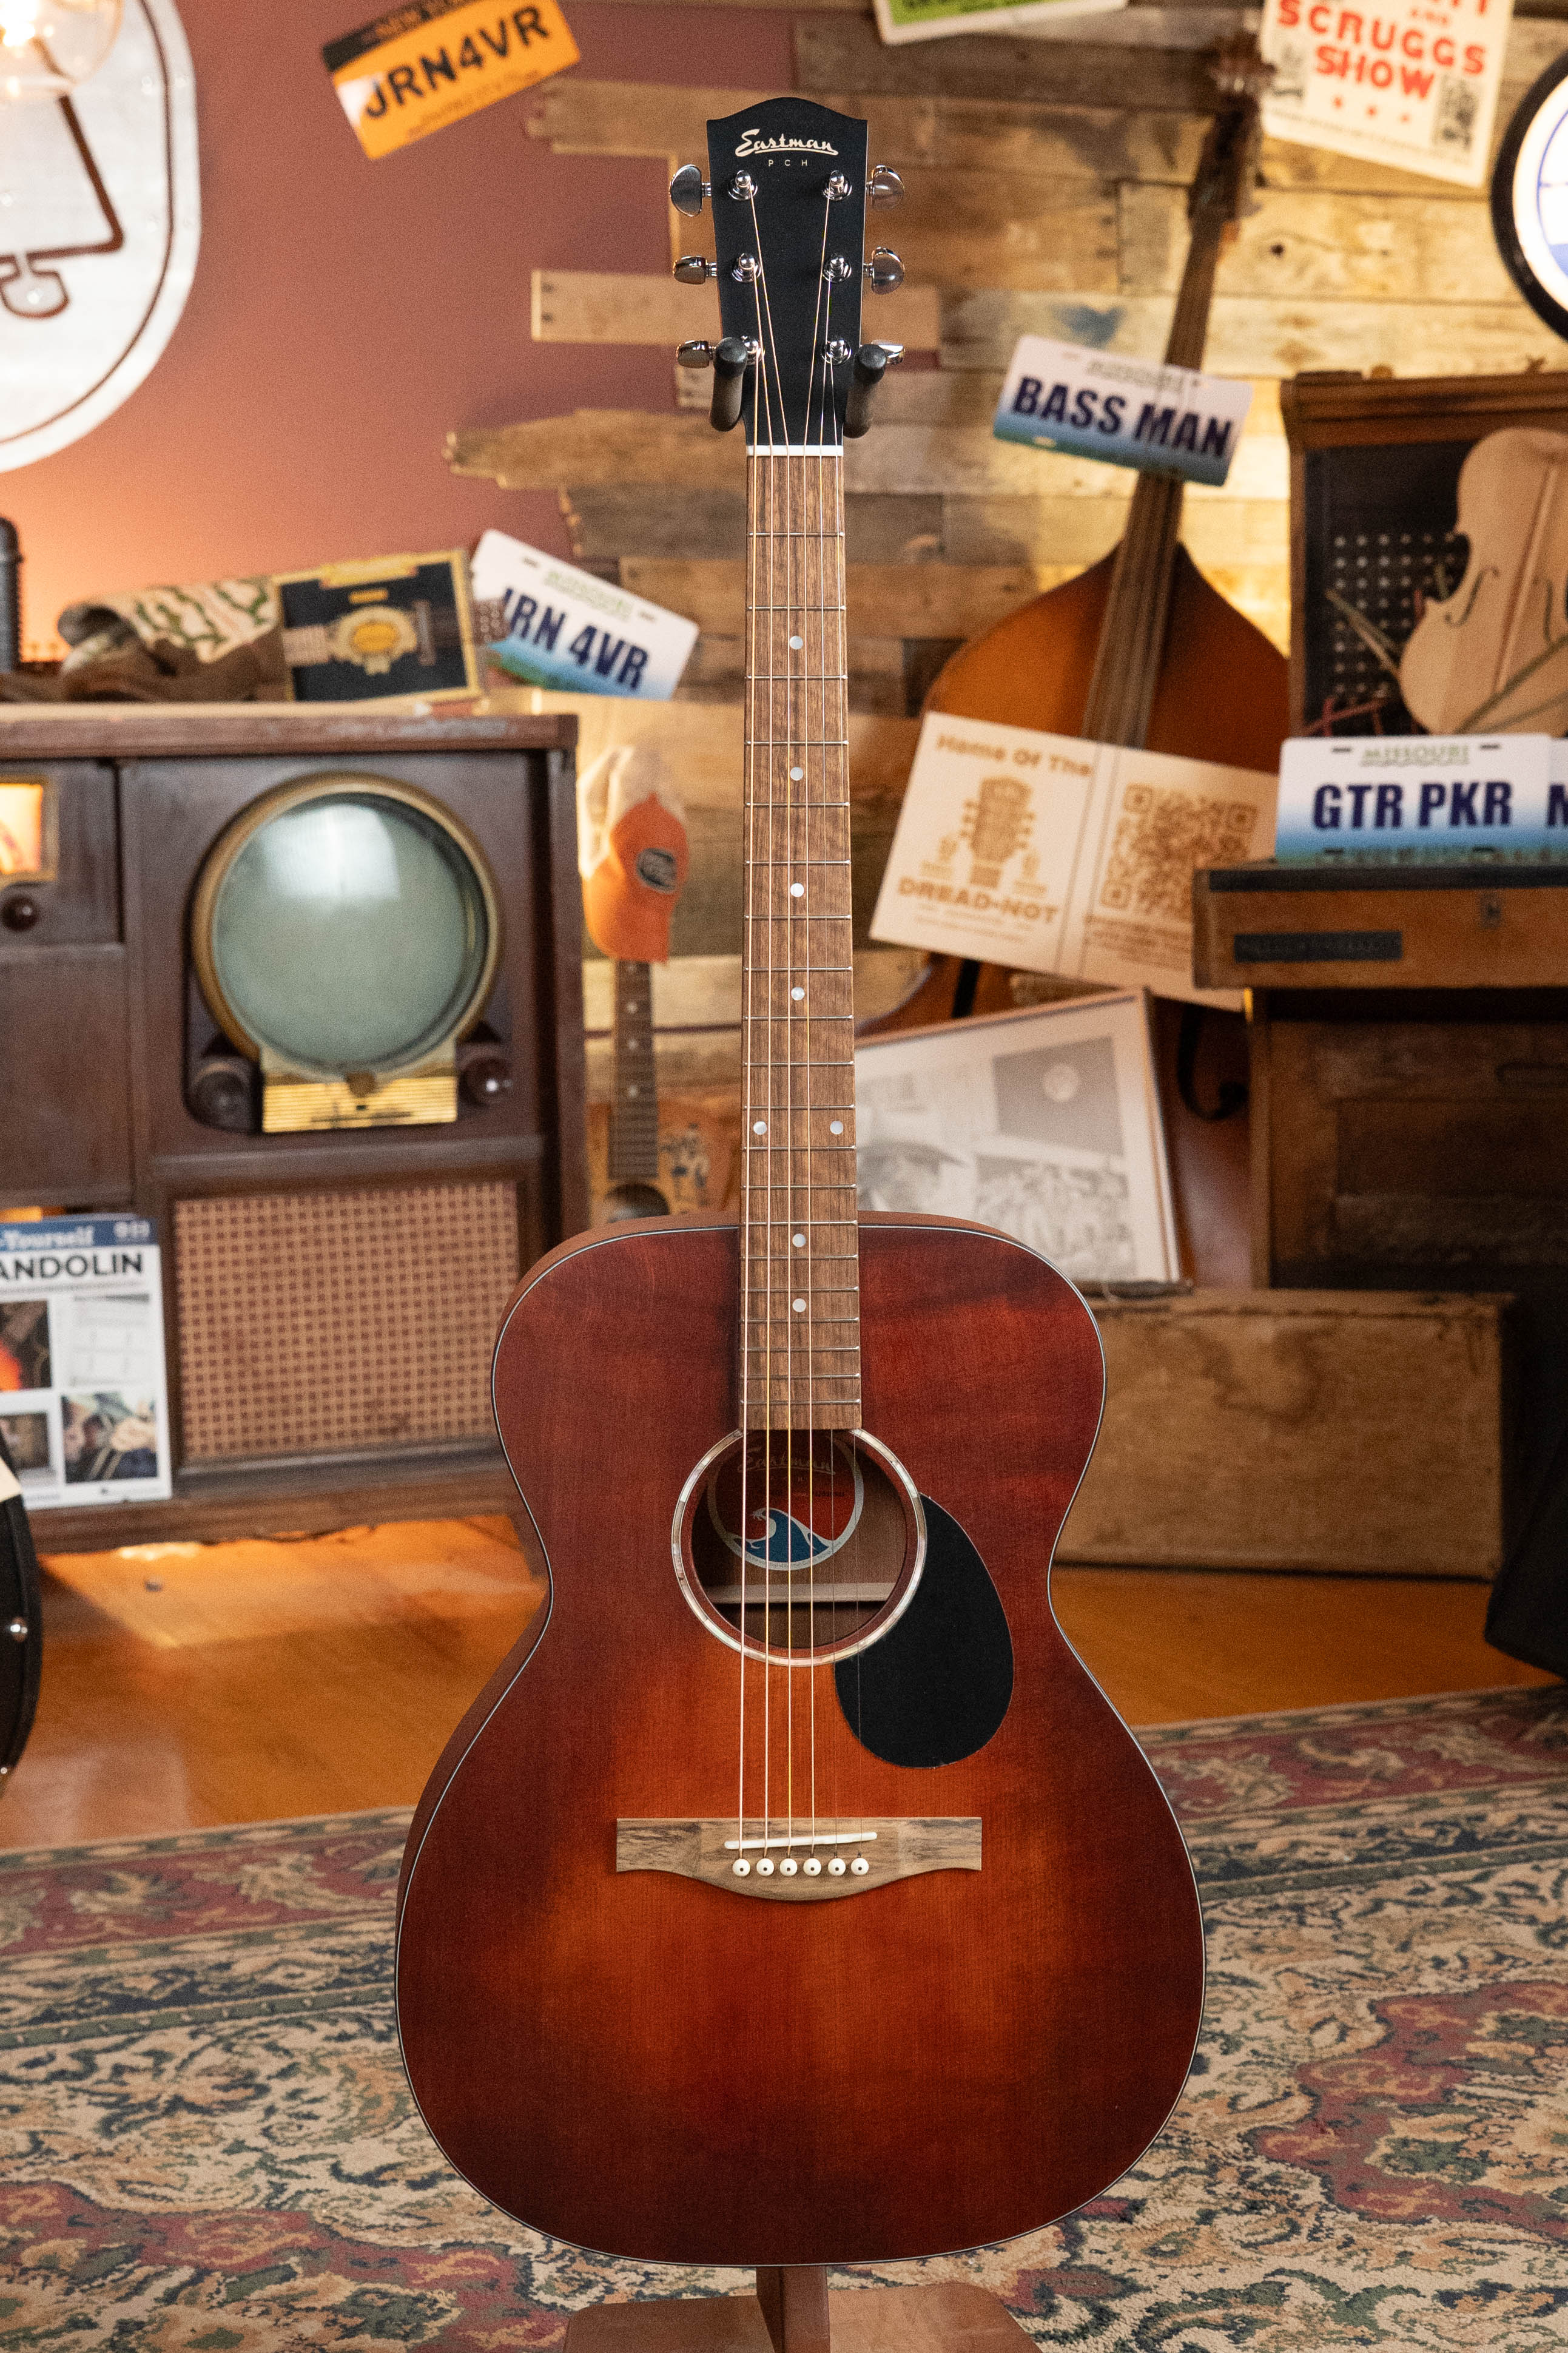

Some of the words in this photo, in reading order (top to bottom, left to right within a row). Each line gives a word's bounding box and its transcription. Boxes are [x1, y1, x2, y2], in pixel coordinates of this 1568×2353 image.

[365, 5, 550, 118] JRN4VR
[1277, 0, 1485, 74] SCRUGGS
[1316, 44, 1434, 100] SHOW
[735, 129, 839, 157] Eastman
[1011, 376, 1126, 434] BASS
[1134, 402, 1232, 457] MAN
[569, 625, 649, 690] 4VR
[1012, 747, 1042, 768] Of
[1048, 754, 1092, 777] The
[1362, 744, 1470, 766] MISSOURI
[1312, 783, 1404, 829] GTR
[1418, 782, 1512, 828] PKR
[898, 877, 1058, 924] DREAD-NOT
